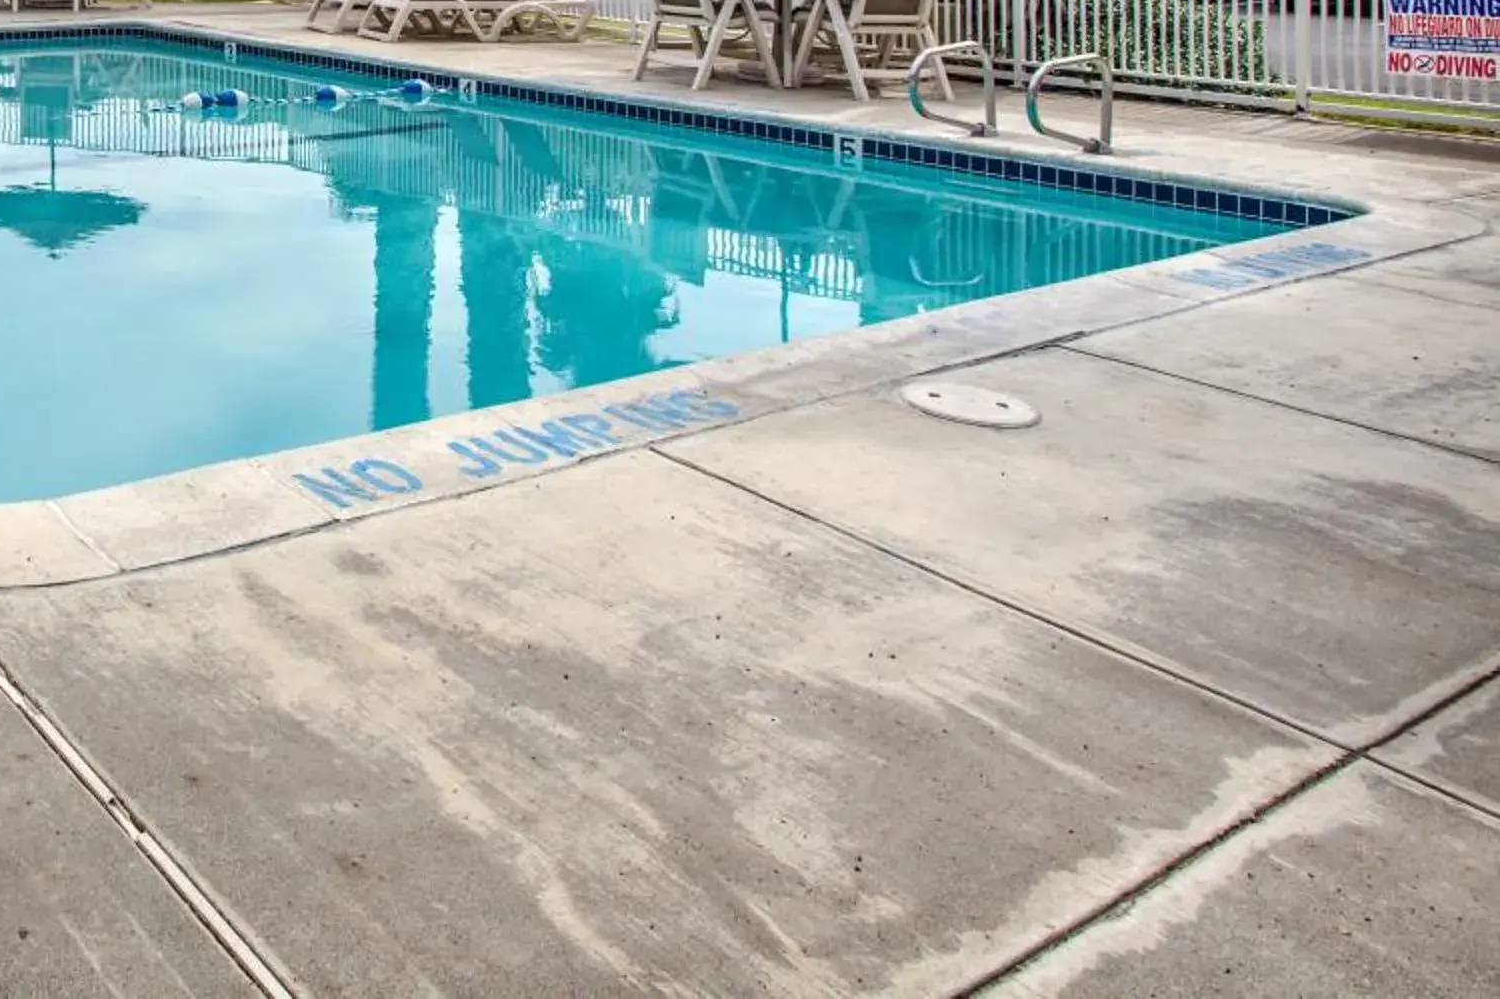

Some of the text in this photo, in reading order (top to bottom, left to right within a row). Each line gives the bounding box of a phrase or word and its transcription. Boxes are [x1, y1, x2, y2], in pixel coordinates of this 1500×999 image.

[1389, 14, 1405, 34] NO
[1408, 15, 1463, 37] LIFEGUARD
[1466, 16, 1481, 38] ON
[1388, 52, 1497, 79] NO DIVING
[292, 456, 423, 509] NO
